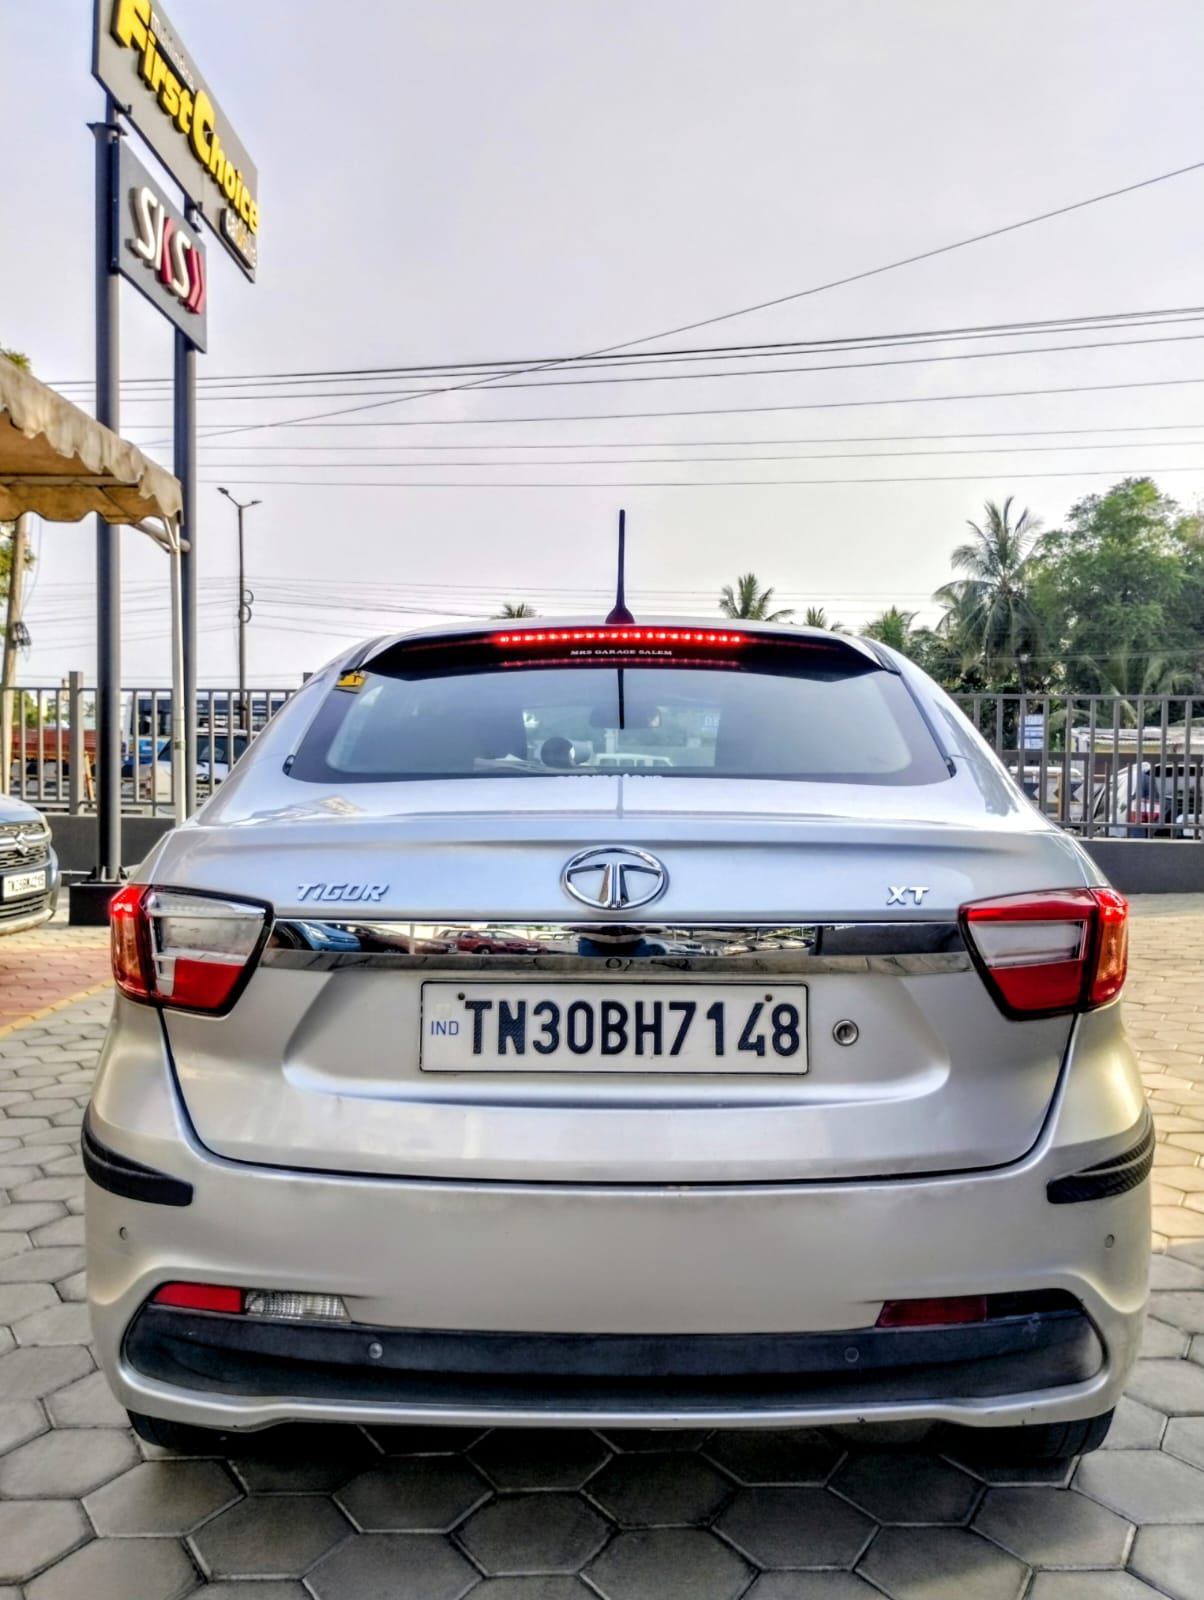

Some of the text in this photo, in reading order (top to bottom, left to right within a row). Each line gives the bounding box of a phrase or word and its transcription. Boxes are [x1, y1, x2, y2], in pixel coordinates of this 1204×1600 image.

[297, 883, 390, 902] TIGOR
[886, 886, 930, 906] XT
[431, 1020, 459, 1036] IND
[464, 1000, 800, 1057] TN30BH7148
